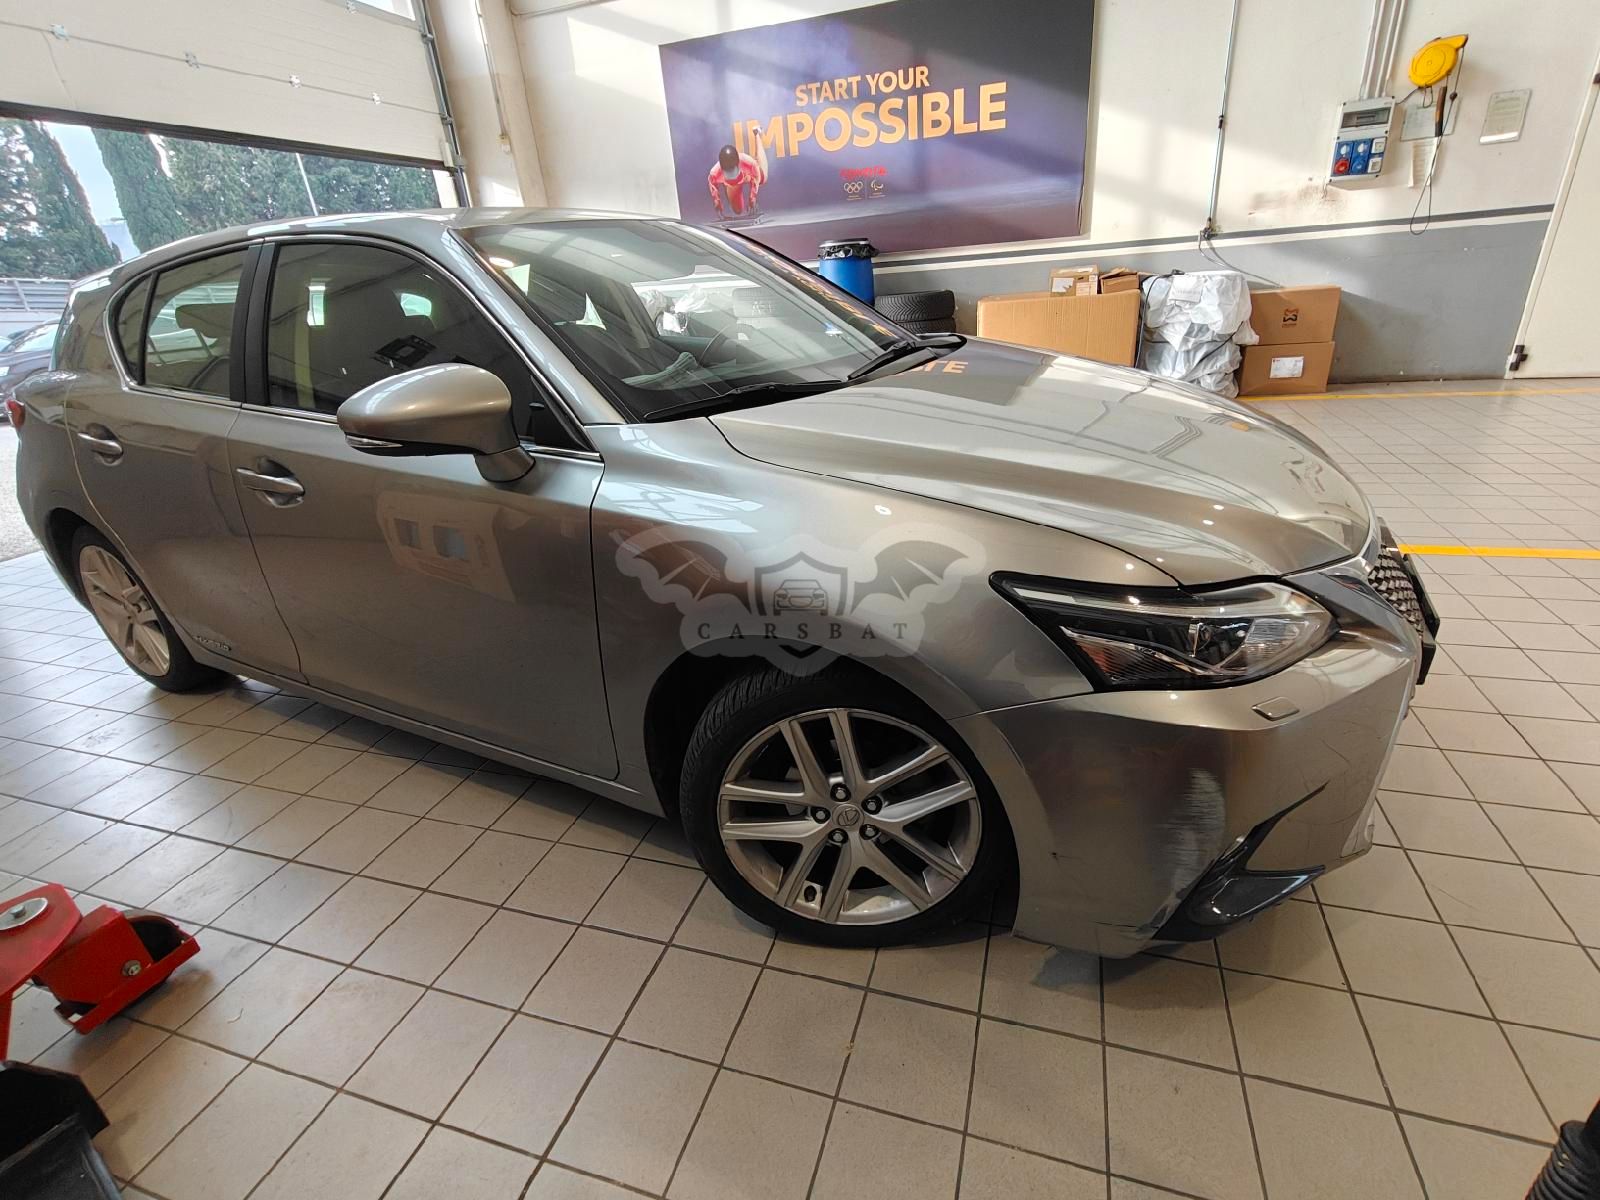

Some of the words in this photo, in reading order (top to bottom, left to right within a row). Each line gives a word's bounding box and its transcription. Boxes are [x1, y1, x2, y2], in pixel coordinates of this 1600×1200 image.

[795, 75, 862, 106] START
[866, 65, 930, 96] YOUR
[732, 81, 1007, 158] IMPOSSIBLE
